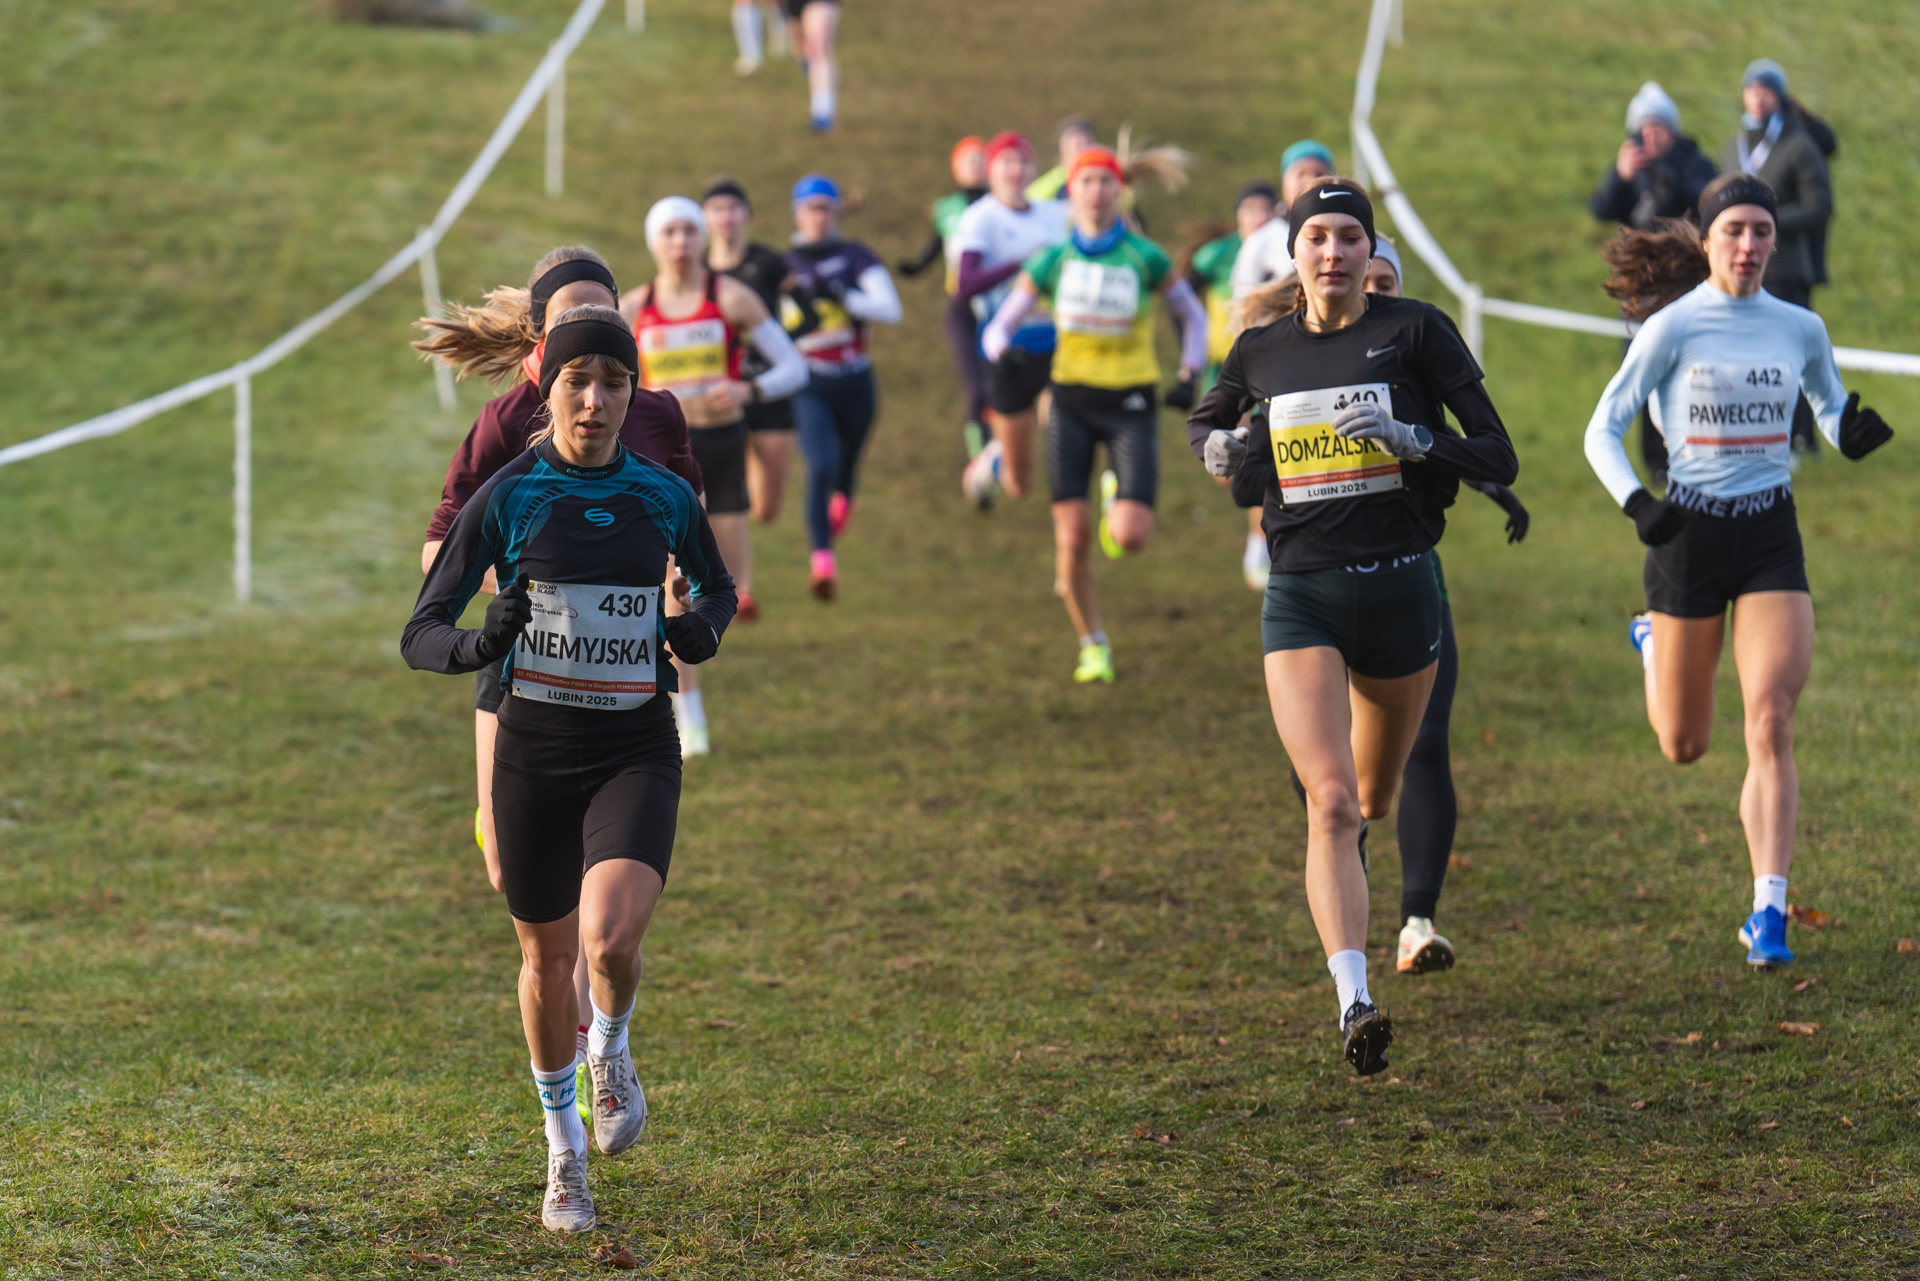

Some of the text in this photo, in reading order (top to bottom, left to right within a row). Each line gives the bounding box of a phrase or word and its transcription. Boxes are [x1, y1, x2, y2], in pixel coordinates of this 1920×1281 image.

[1746, 367, 1783, 388] 442
[1689, 400, 1787, 425] PAWEŁCZYK
[1277, 429, 1382, 464] DOMŻALSK
[1308, 482, 1368, 497] LUBIN 2025
[1671, 483, 1729, 518] NIKE
[1731, 487, 1776, 519] PRO
[598, 593, 647, 618] 430
[520, 628, 651, 665] NIEMYJSKA
[547, 690, 617, 706] LUBIN 2025
[570, 680, 587, 688] Polski
[593, 682, 616, 691] Biegach
